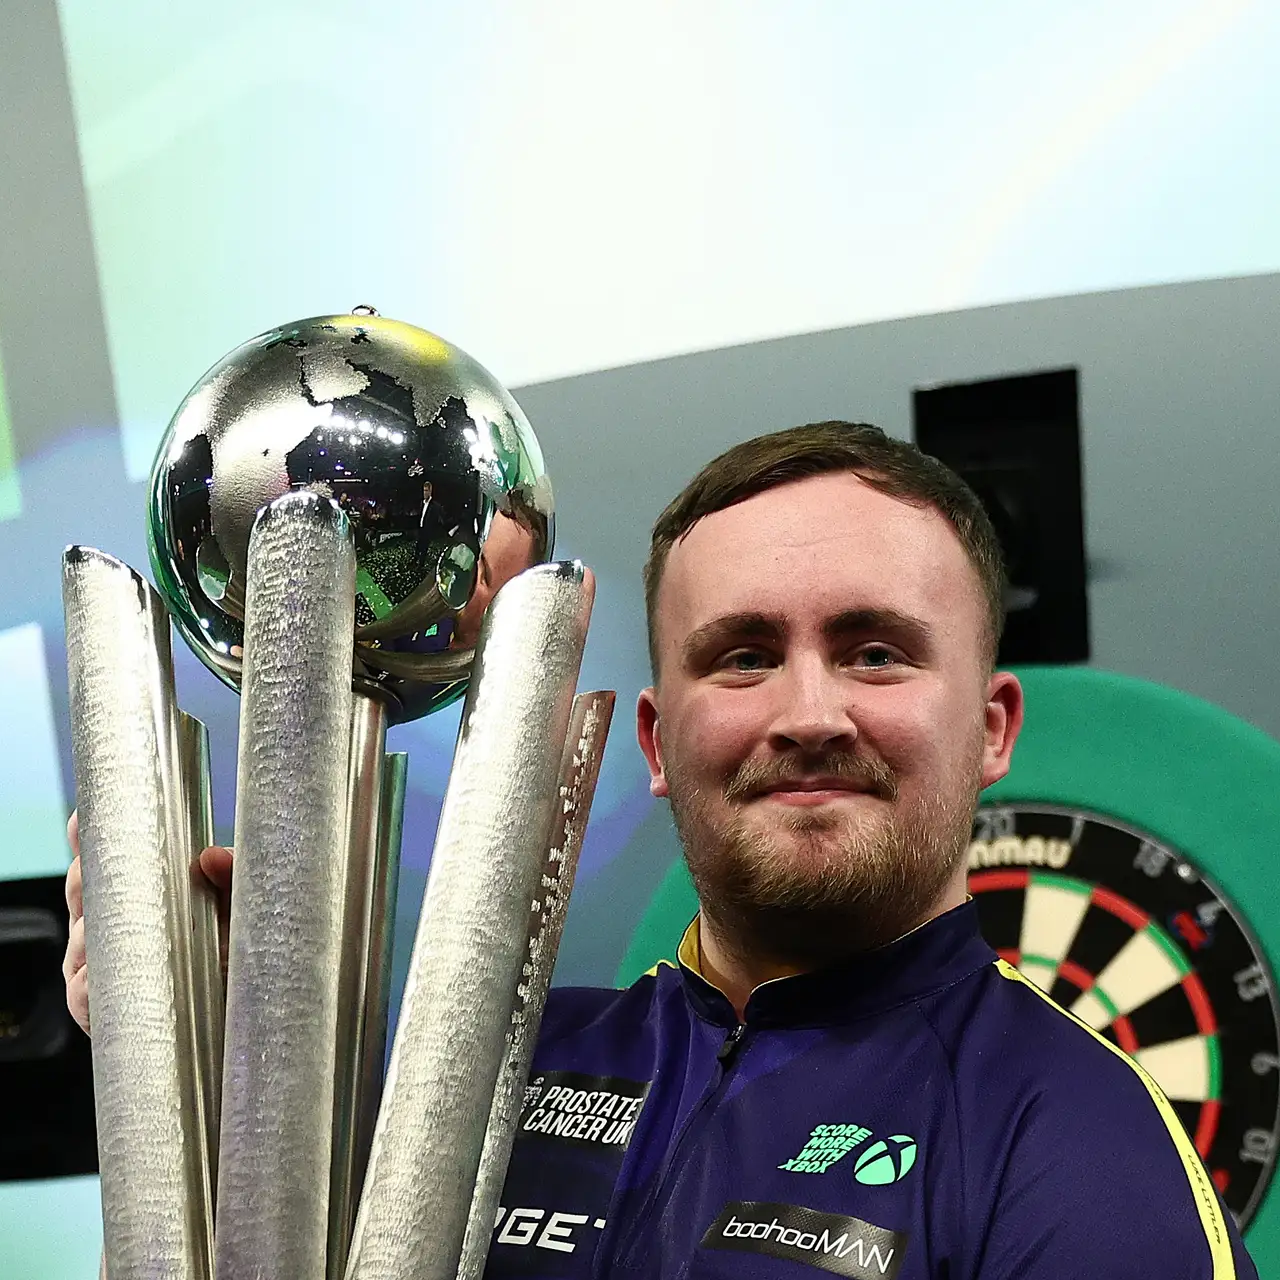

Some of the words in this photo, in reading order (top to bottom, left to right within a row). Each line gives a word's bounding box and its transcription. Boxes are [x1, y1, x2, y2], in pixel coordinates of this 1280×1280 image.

[538, 1085, 644, 1121] PROSTATE
[523, 1108, 608, 1141] CANCER
[601, 1120, 637, 1145] UK
[809, 1123, 873, 1142] SCORE
[803, 1136, 860, 1152] MORE
[796, 1148, 848, 1162] WITH
[777, 1158, 836, 1174] XBOX
[722, 1215, 895, 1274] boohooMAN
